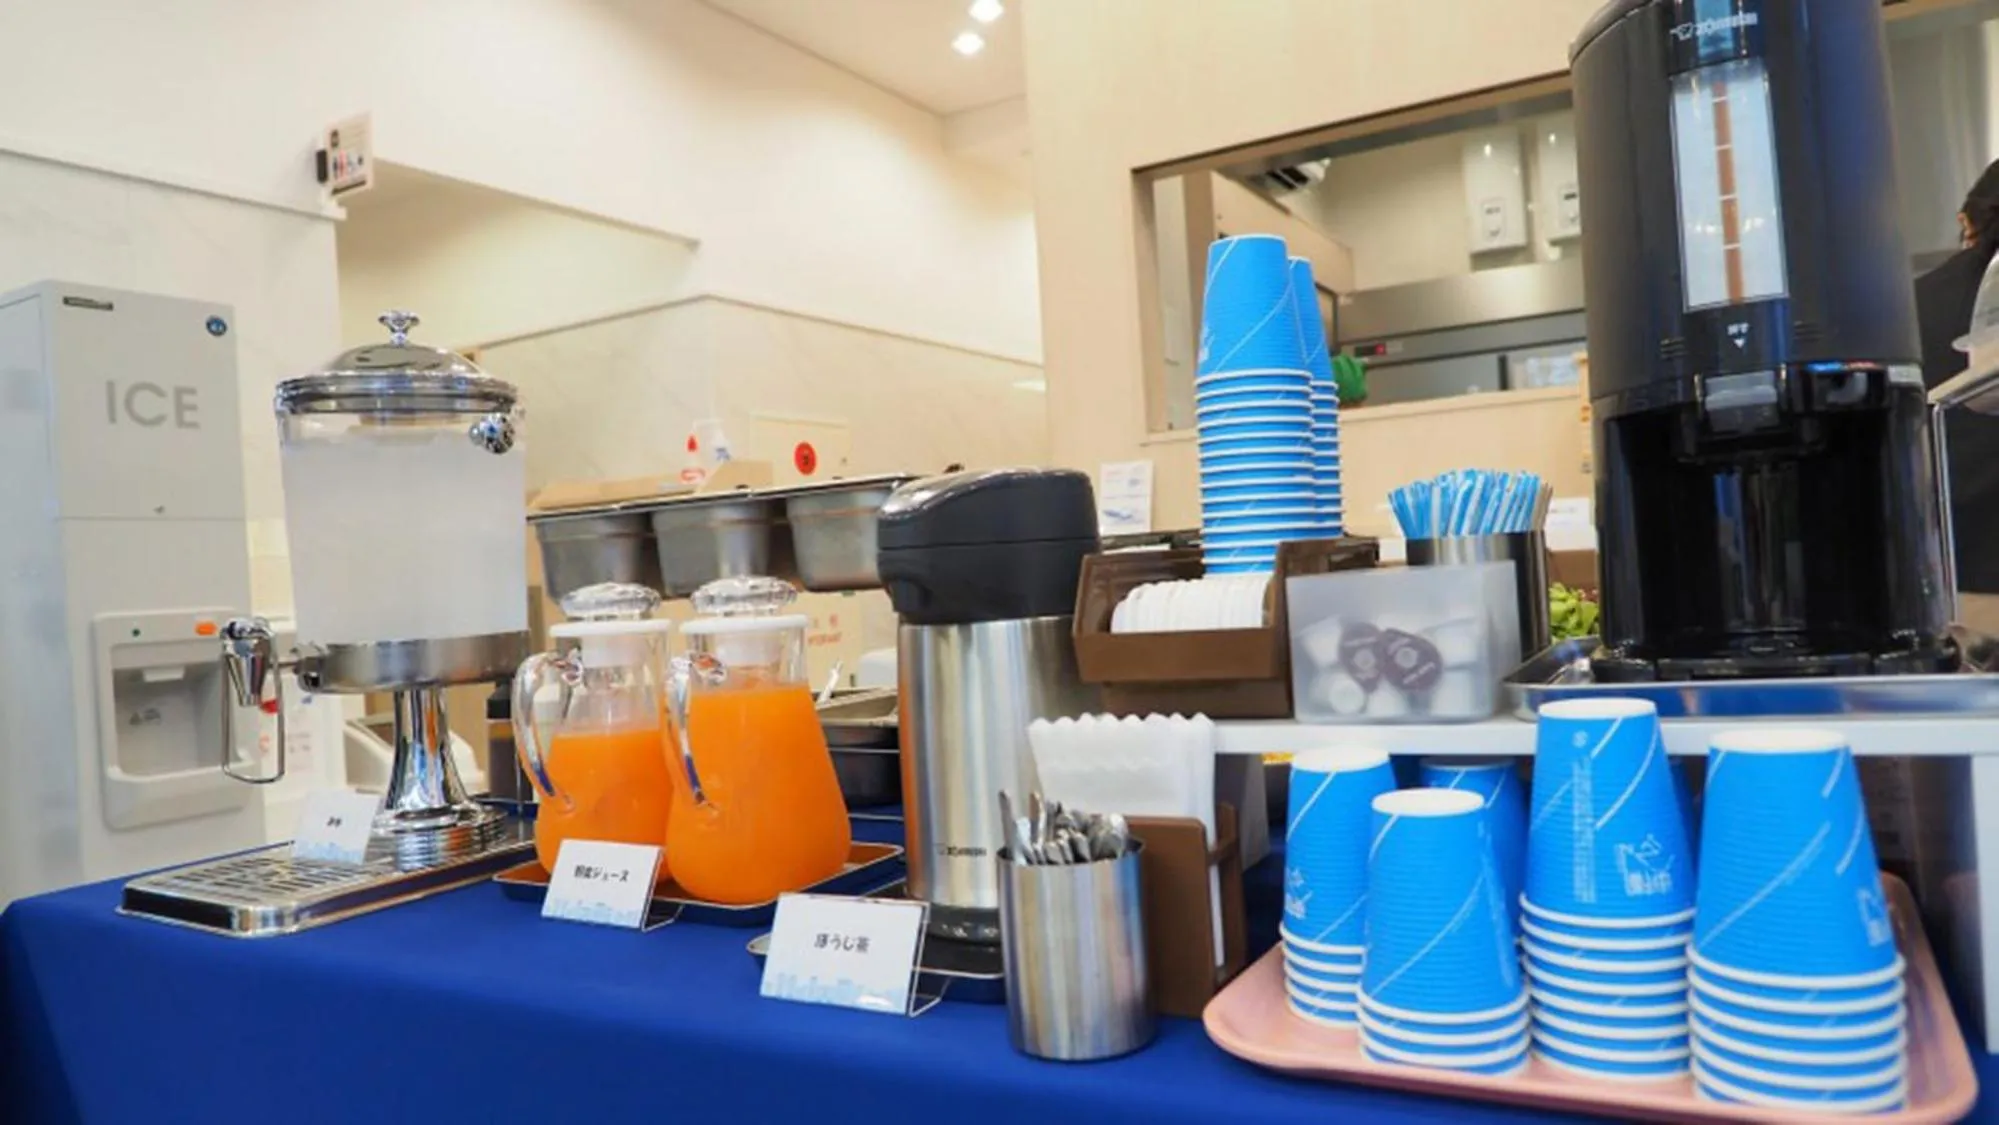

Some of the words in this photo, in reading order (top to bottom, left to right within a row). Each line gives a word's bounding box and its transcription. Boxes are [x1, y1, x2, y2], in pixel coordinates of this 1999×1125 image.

[106, 380, 201, 429] ICE
[814, 932, 871, 953] ほうじ茶
